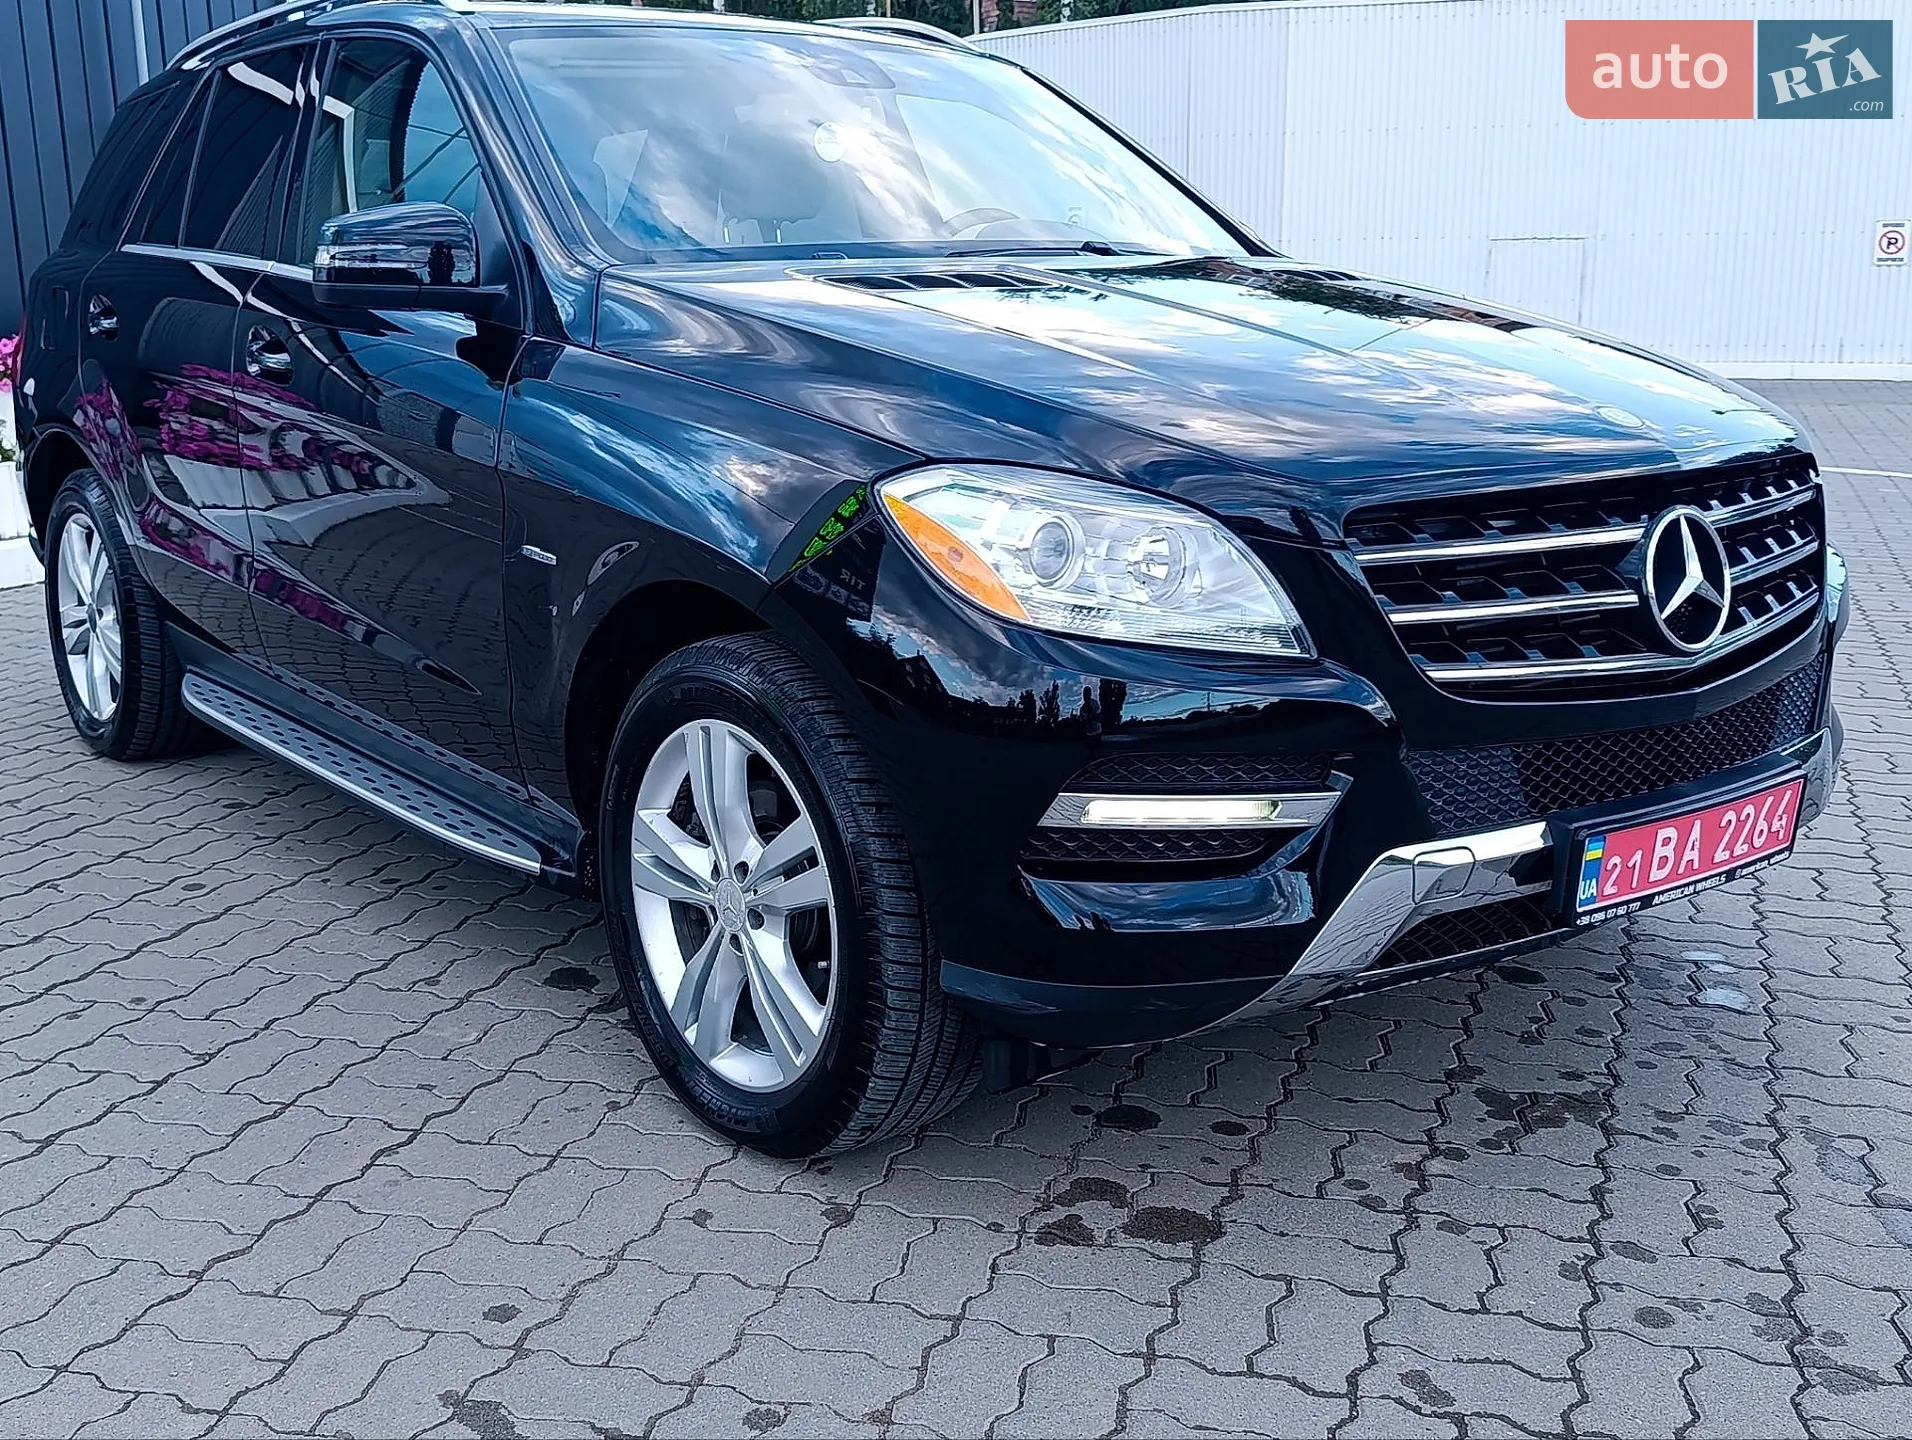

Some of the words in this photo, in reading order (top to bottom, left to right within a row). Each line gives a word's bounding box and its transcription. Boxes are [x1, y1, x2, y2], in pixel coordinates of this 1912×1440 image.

[1886, 237, 1899, 250] P
[1602, 849, 1643, 896] 21
[1649, 819, 1701, 883] BA
[1712, 789, 1793, 865] 2264
[1579, 879, 1598, 900] UA
[1652, 884, 1695, 905] AMERICAN
[1695, 874, 1727, 892] WHEELS
